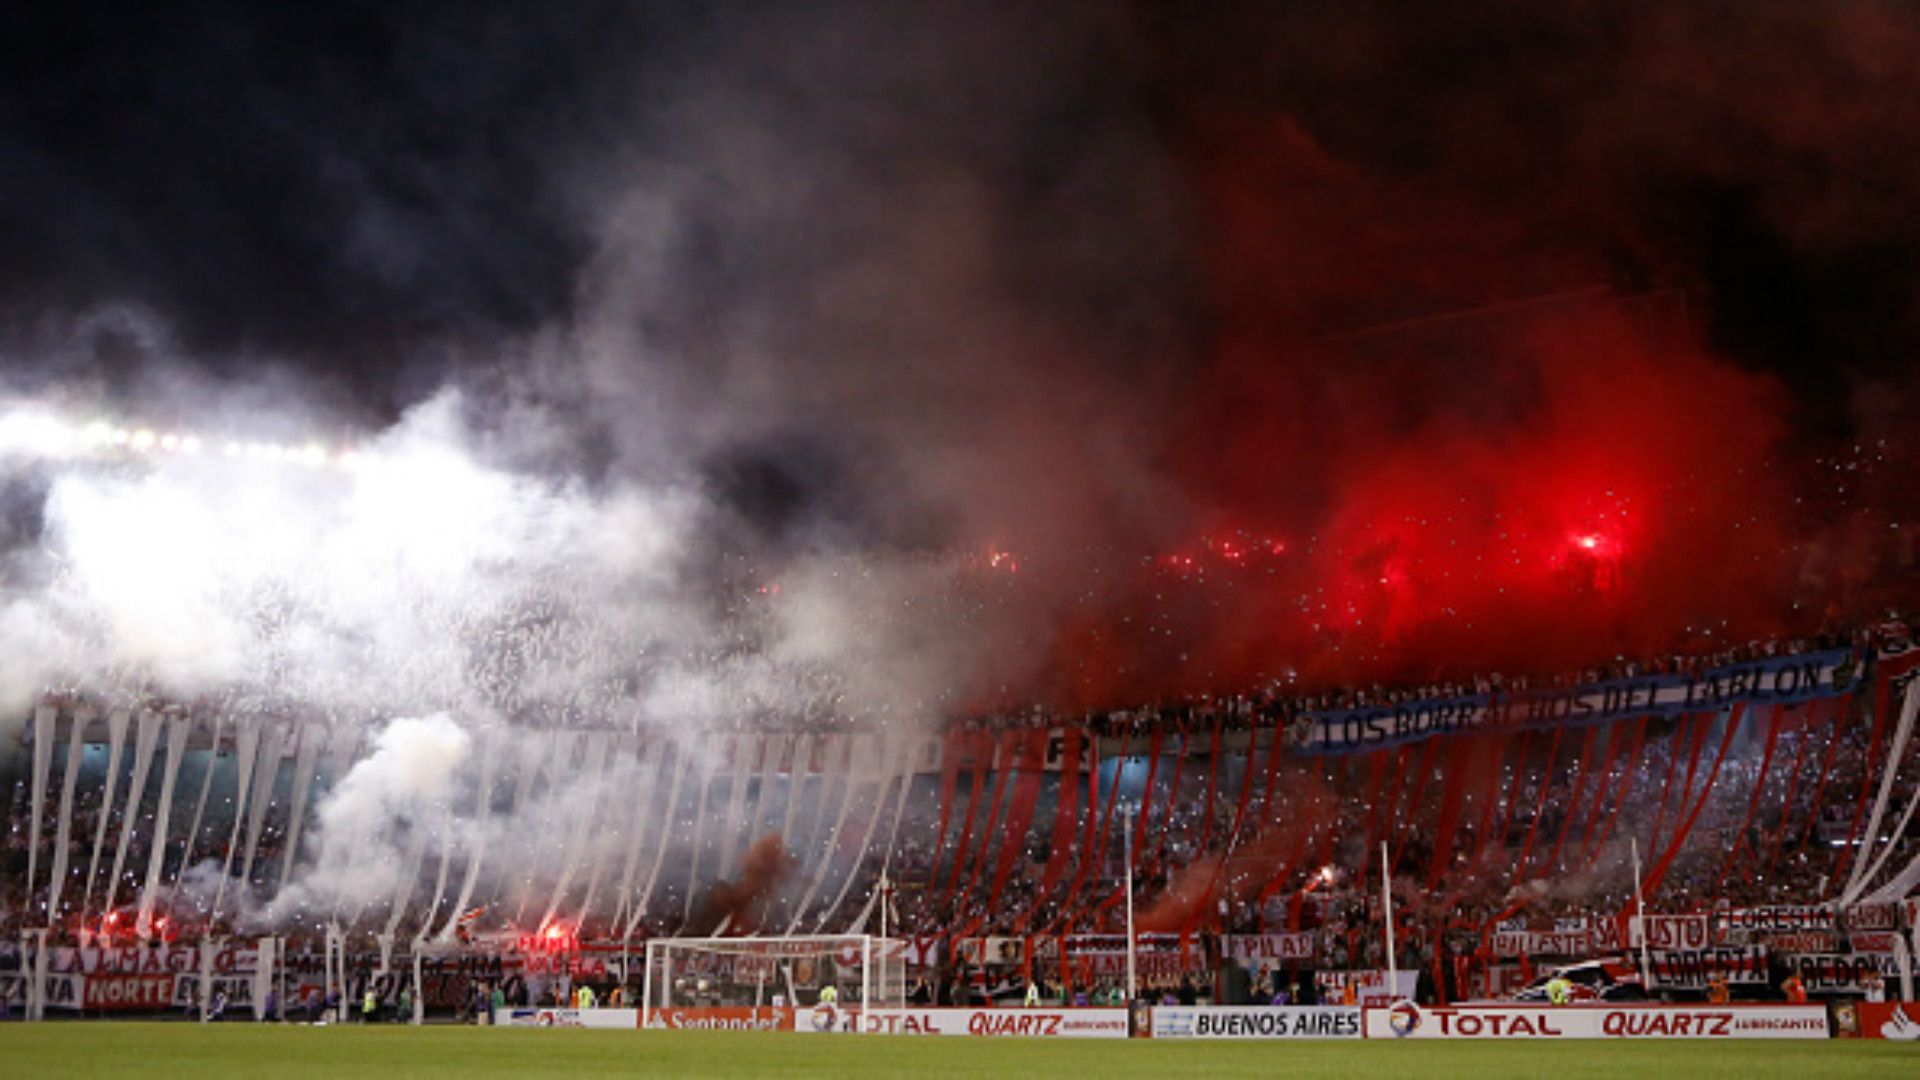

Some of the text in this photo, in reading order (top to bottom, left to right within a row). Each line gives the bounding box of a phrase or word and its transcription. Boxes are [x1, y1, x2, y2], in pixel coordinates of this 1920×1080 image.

[1321, 713, 1386, 748] LOS
[1604, 682, 1659, 713] DEL
[1245, 936, 1311, 957] PILAR
[66, 949, 233, 973] ALMAGO
[88, 980, 172, 1002] NORTE
[968, 1012, 1063, 1034] QUARTZ
[1197, 1013, 1359, 1035] BUENOS AIRES
[1431, 1010, 1562, 1035] TOTAL
[1602, 1012, 1734, 1035] QUARTZ
